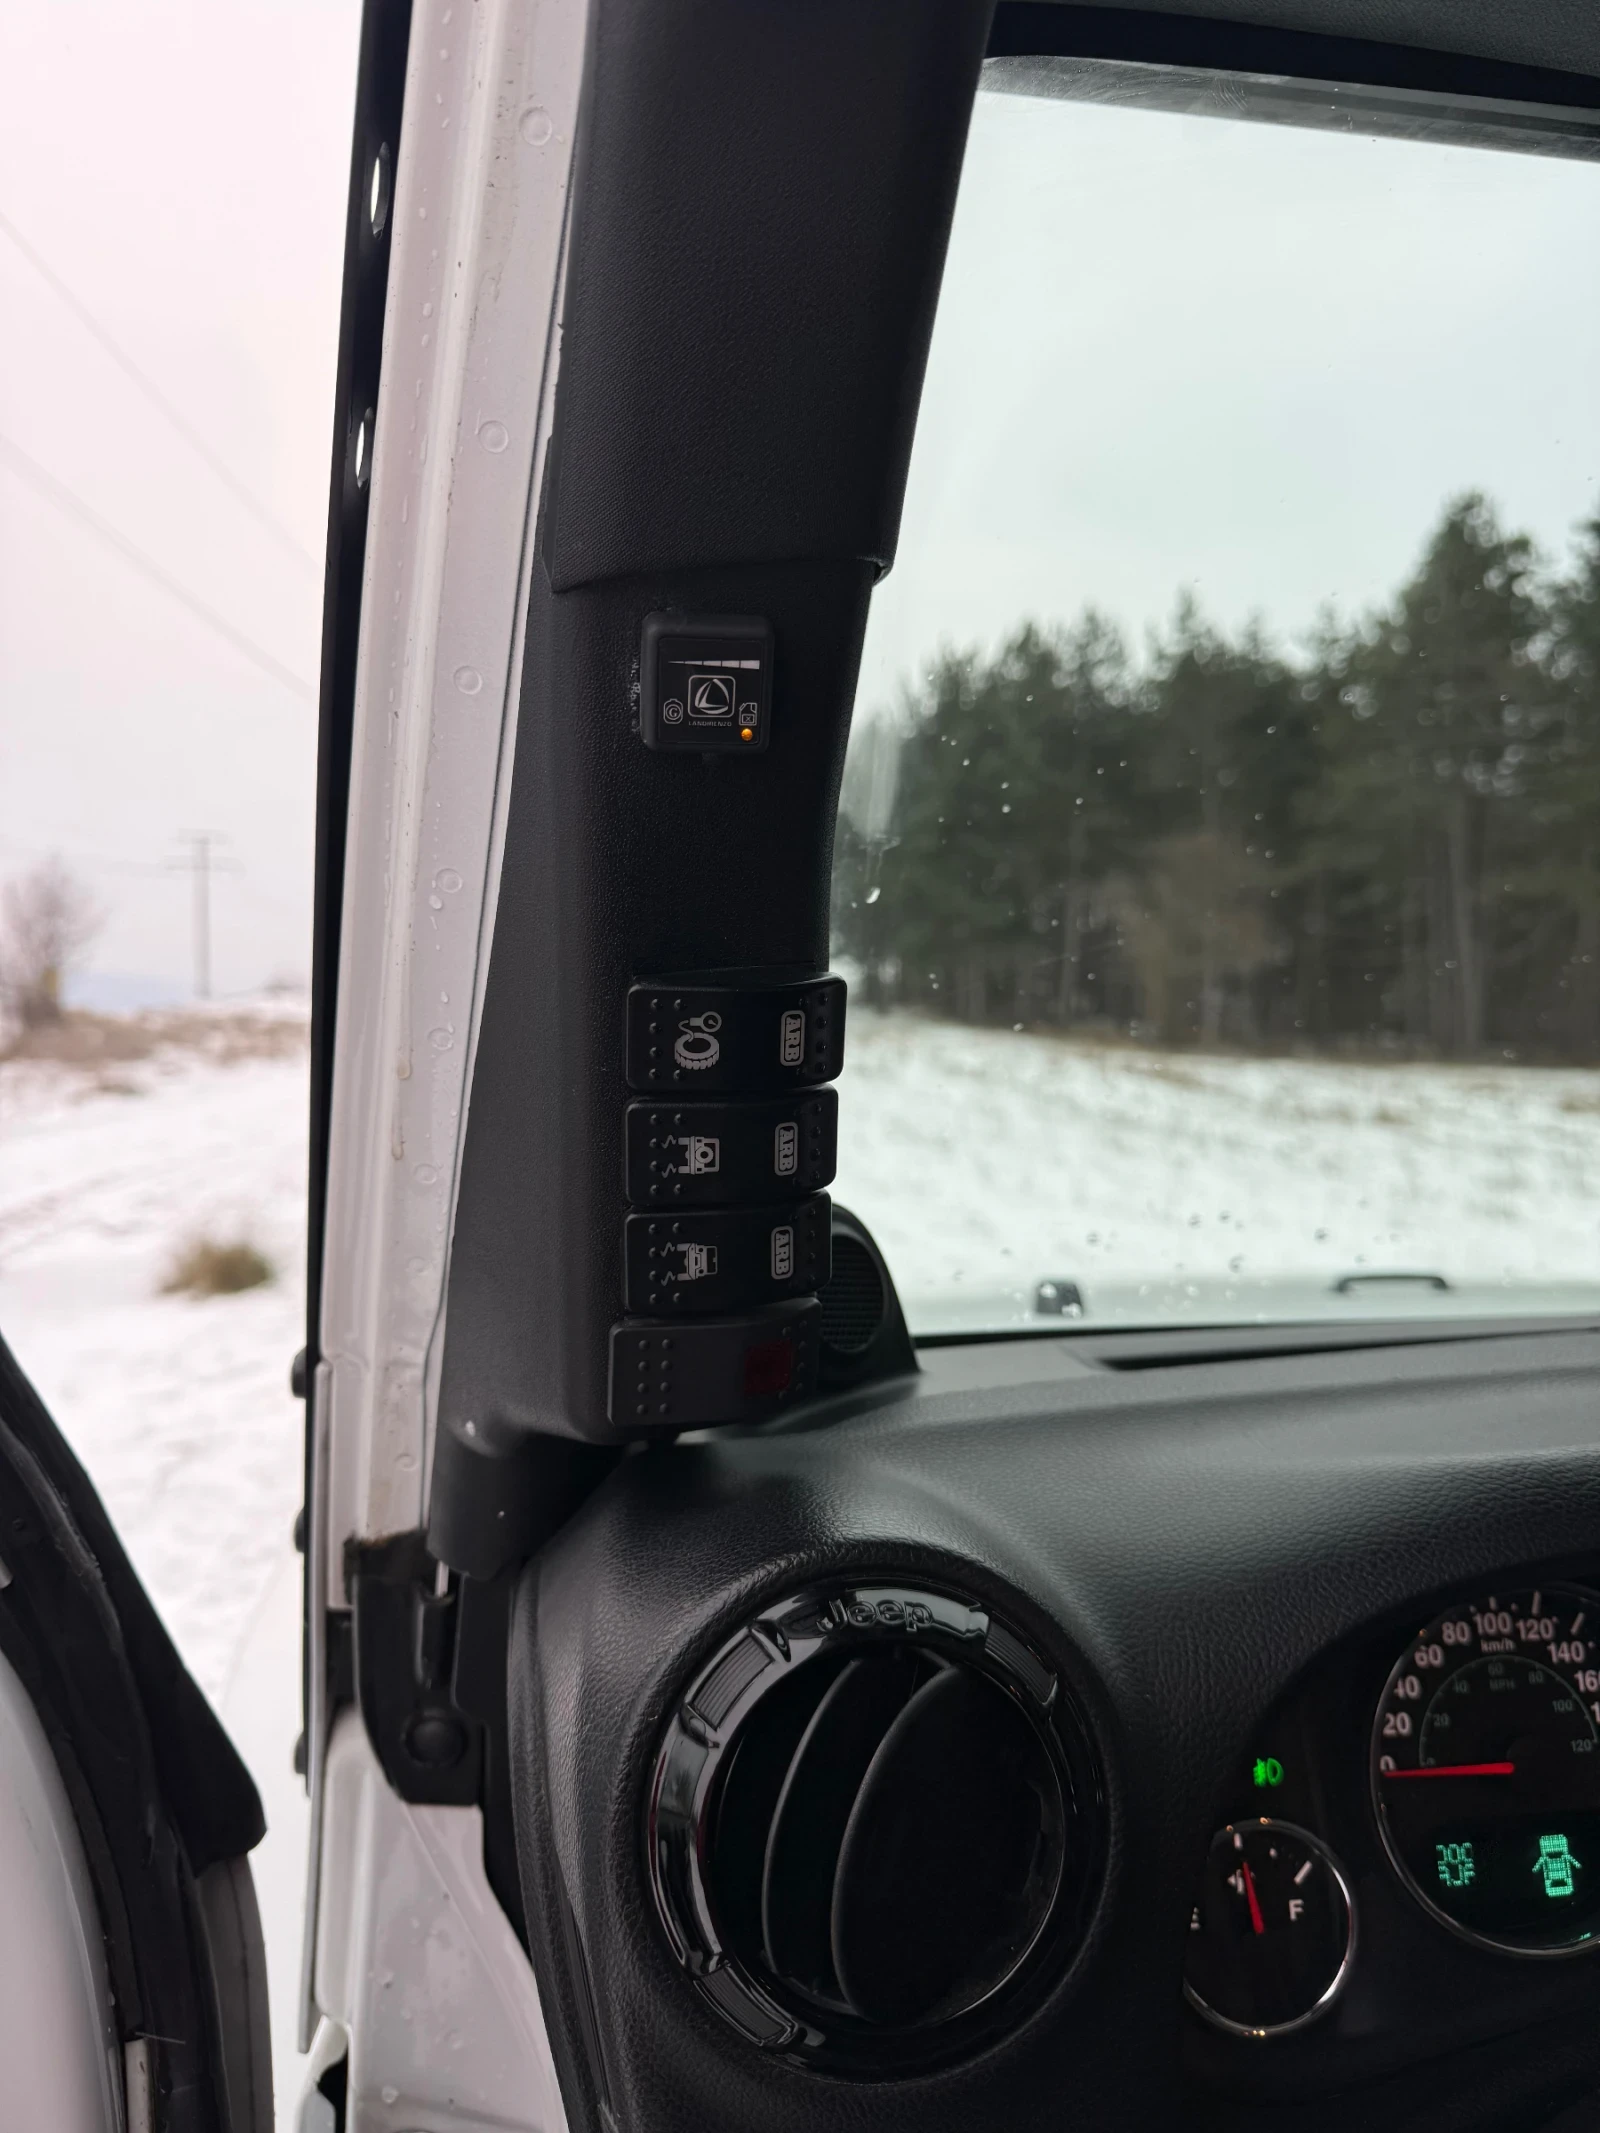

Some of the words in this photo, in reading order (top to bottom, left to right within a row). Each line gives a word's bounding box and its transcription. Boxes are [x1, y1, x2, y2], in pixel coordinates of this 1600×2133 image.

[816, 1599, 933, 1633] Jeep
[1473, 1612, 1512, 1635] 100
[1441, 1621, 1470, 1645] 80
[1516, 1618, 1554, 1640] 120
[1414, 1645, 1443, 1668] 60
[1481, 1639, 1514, 1653] km/h
[1547, 1640, 1585, 1663] 140
[1488, 1663, 1503, 1676] 60
[1574, 1669, 1600, 1692] 16
[1394, 1675, 1421, 1698] 40
[1489, 1678, 1515, 1690] MPH
[1552, 1700, 1573, 1712] 100
[1383, 1712, 1412, 1735] 20
[1433, 1713, 1449, 1727] 20
[1571, 1739, 1592, 1752] 120
[1288, 1899, 1304, 1922] F
